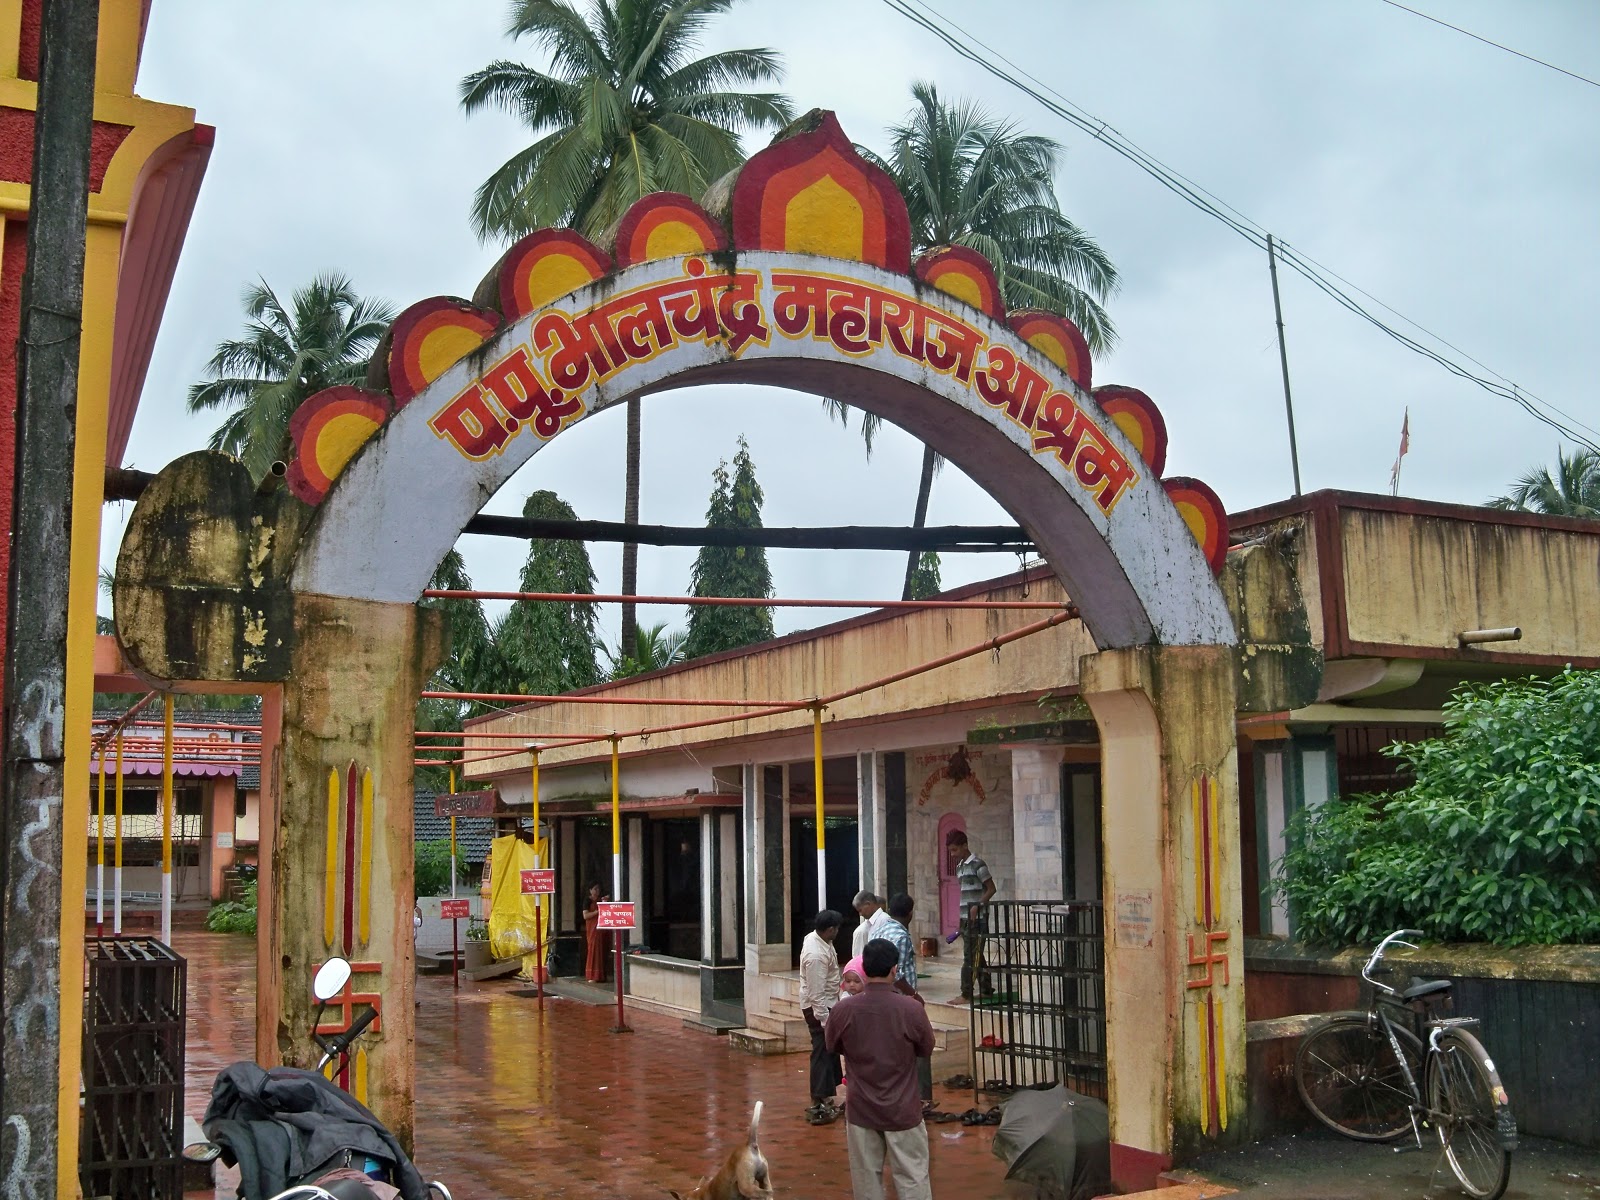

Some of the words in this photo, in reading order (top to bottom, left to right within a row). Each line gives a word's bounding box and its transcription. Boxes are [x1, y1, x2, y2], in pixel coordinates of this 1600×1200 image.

[532, 257, 768, 389] भालचंद्र
[771, 269, 985, 386] महाराज
[975, 344, 1139, 516] आश्रम
